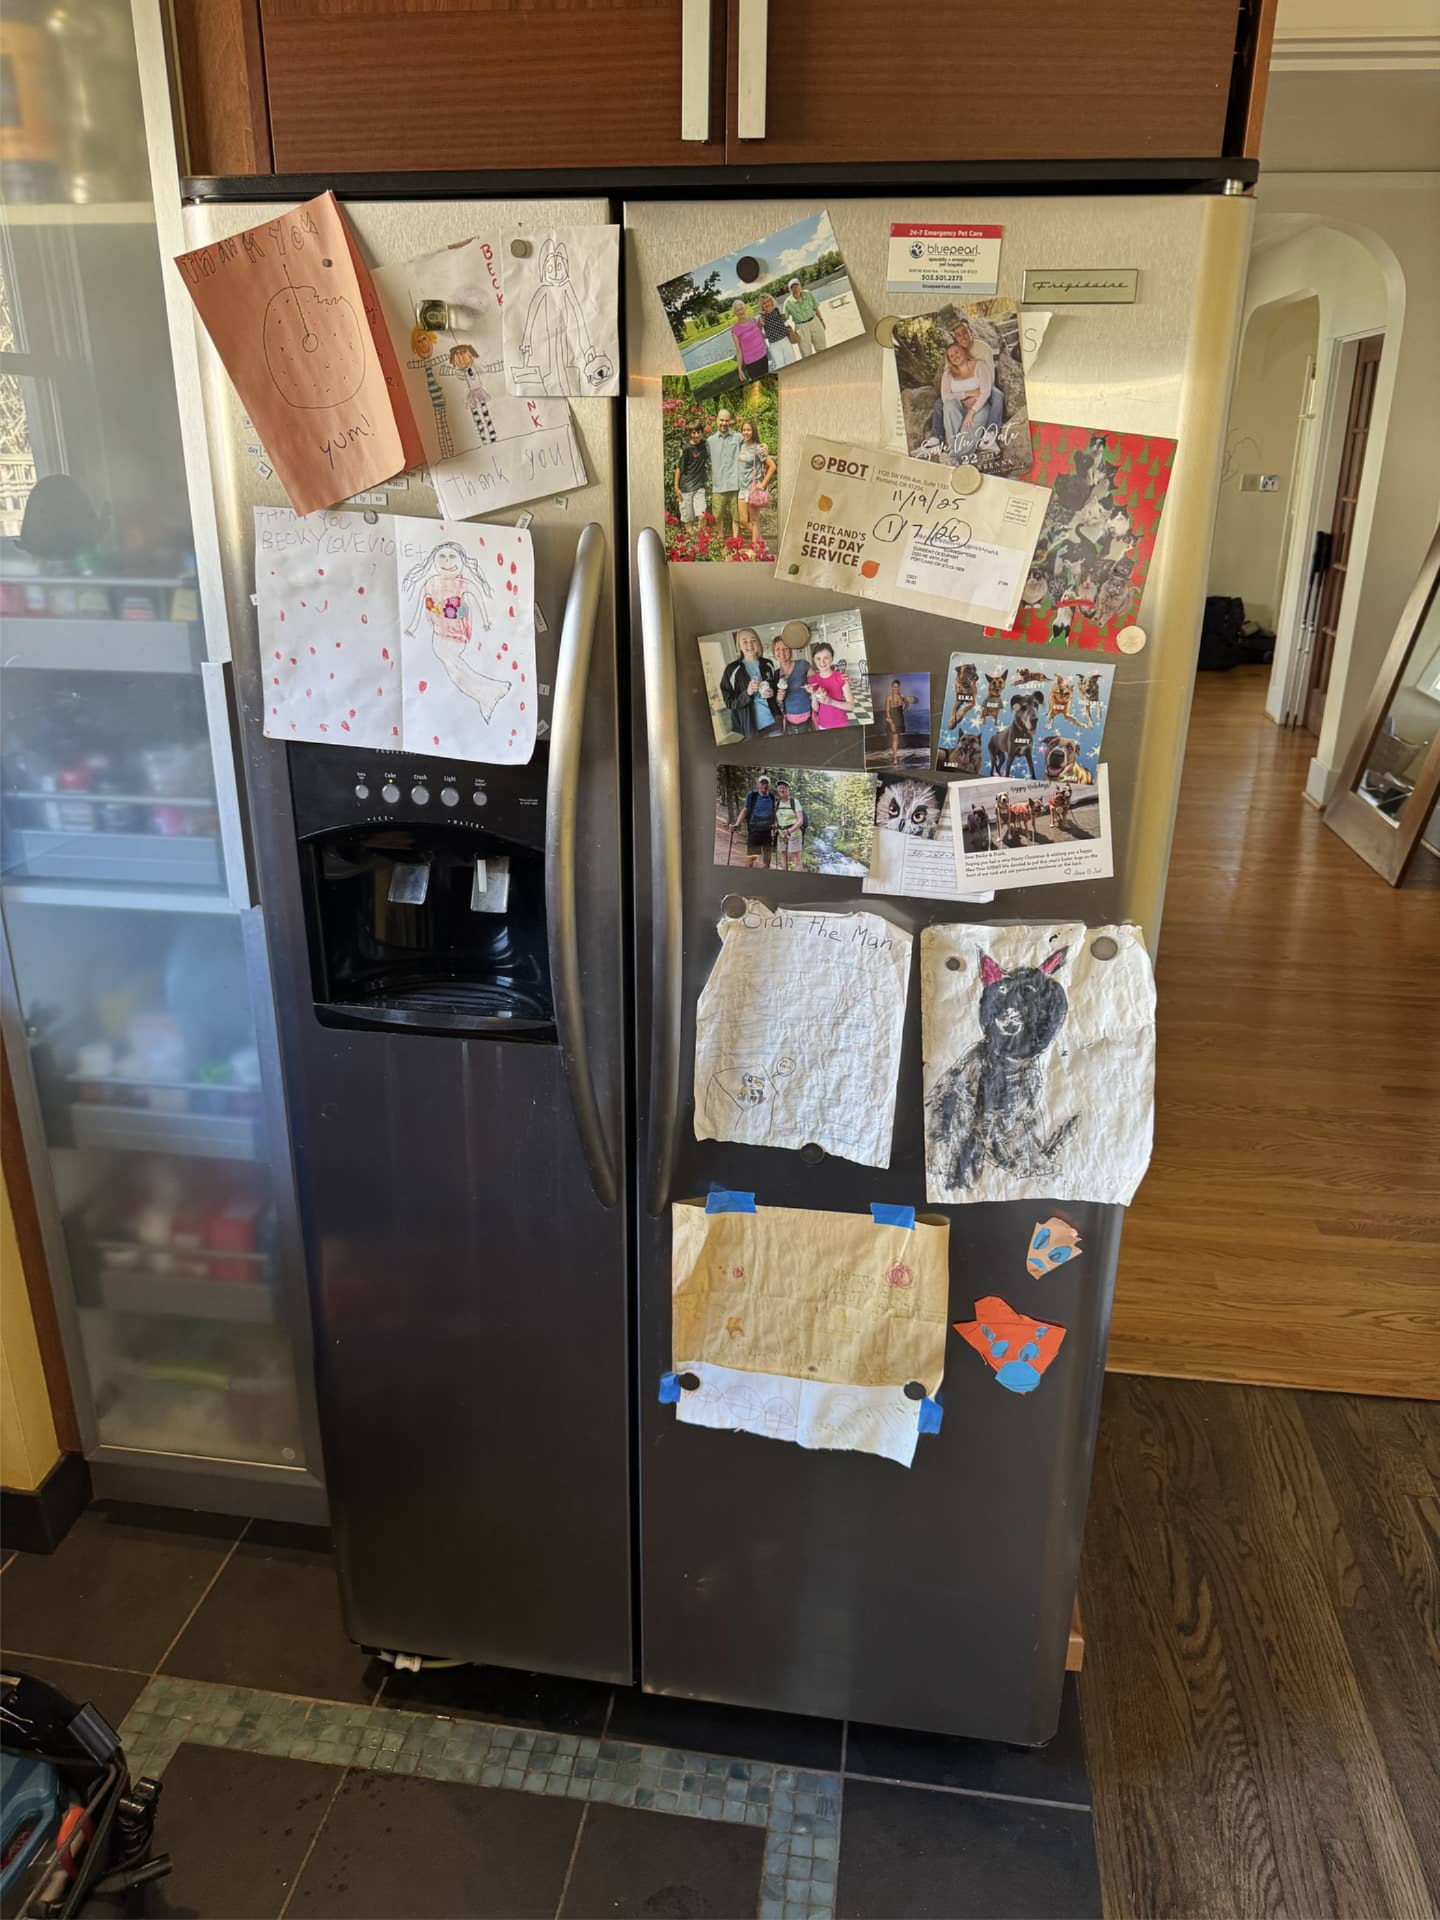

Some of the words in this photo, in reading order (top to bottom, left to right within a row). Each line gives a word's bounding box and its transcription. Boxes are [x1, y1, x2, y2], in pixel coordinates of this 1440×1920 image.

[923, 229, 957, 237] Emergency
[480, 243, 503, 307] BECK
[1032, 281, 1129, 292] Frigidaire
[920, 439, 952, 457] Save
[974, 422, 1019, 450] Date
[827, 456, 869, 477] PBOT
[961, 453, 978, 465] 22
[900, 473, 911, 481] Fifth
[806, 521, 867, 541] PORTLAND'S
[803, 531, 836, 548] LEAF
[838, 538, 865, 554] DAY
[800, 544, 860, 567] SERVICE
[1010, 785, 1026, 793] Happy
[453, 820, 479, 829] WATER
[851, 924, 894, 951] Man
